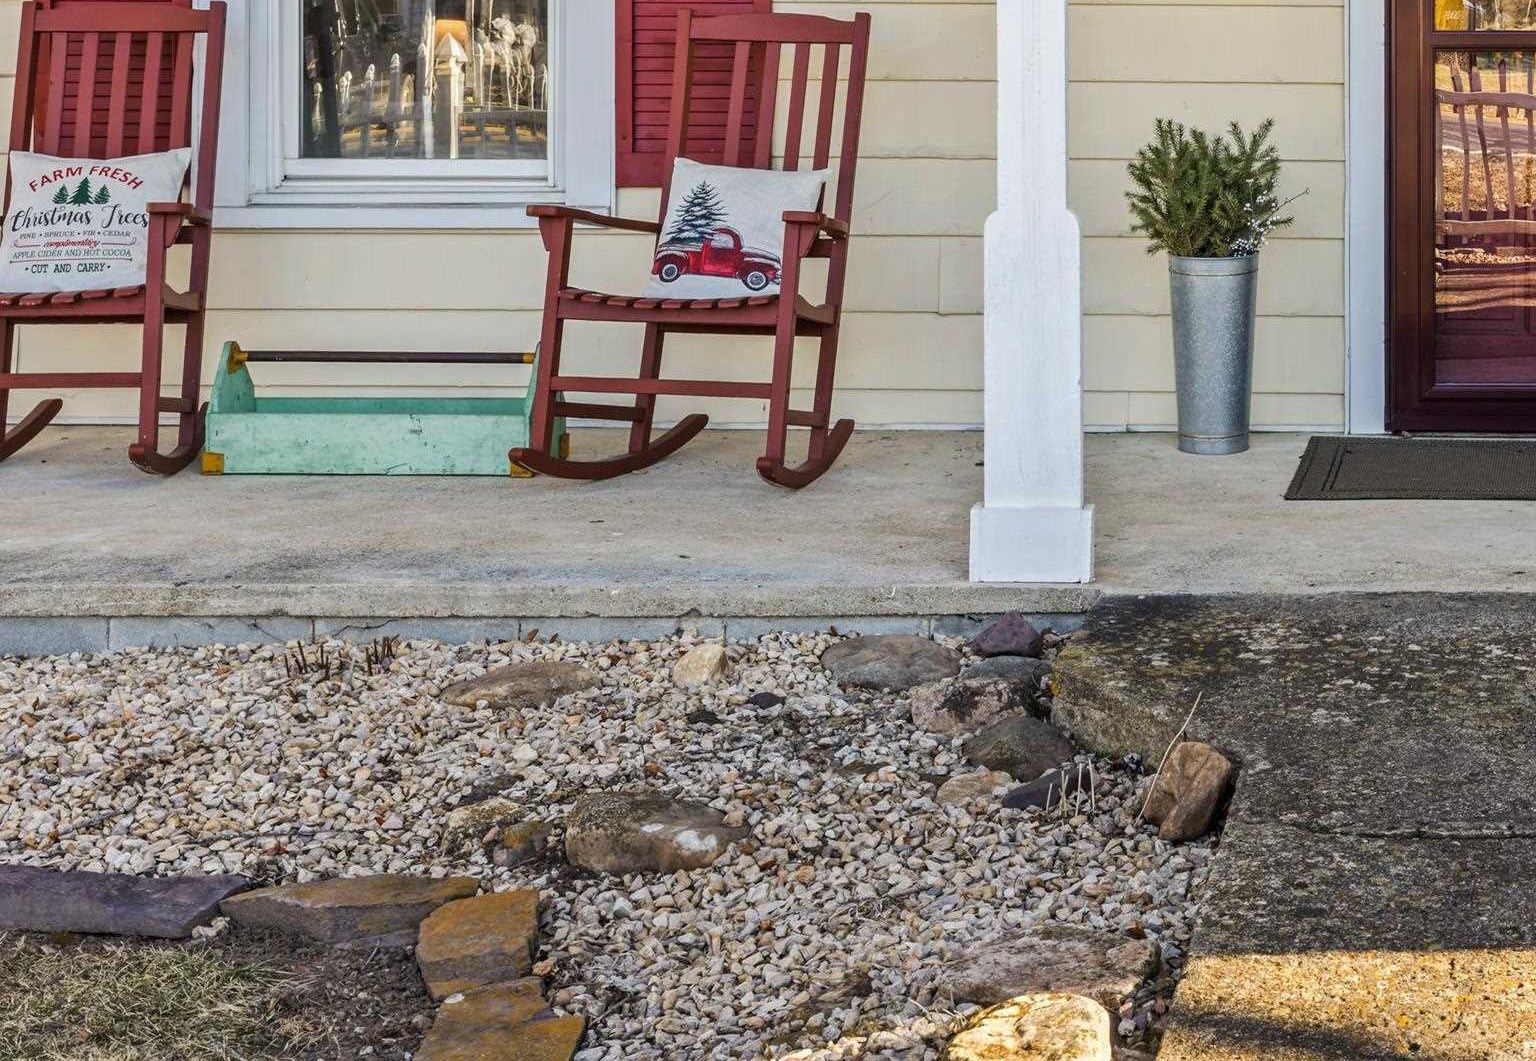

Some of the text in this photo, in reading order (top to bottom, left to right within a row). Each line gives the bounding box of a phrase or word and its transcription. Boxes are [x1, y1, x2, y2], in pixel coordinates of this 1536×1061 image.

[28, 165, 145, 192] FARM FRESH
[10, 203, 149, 232] Christmas Trees
[12, 250, 36, 259] APPLE
[37, 249, 63, 258] CIDER
[64, 249, 82, 257] AND
[102, 249, 132, 257] COCOA
[31, 262, 106, 274] CUT AND CARRY
